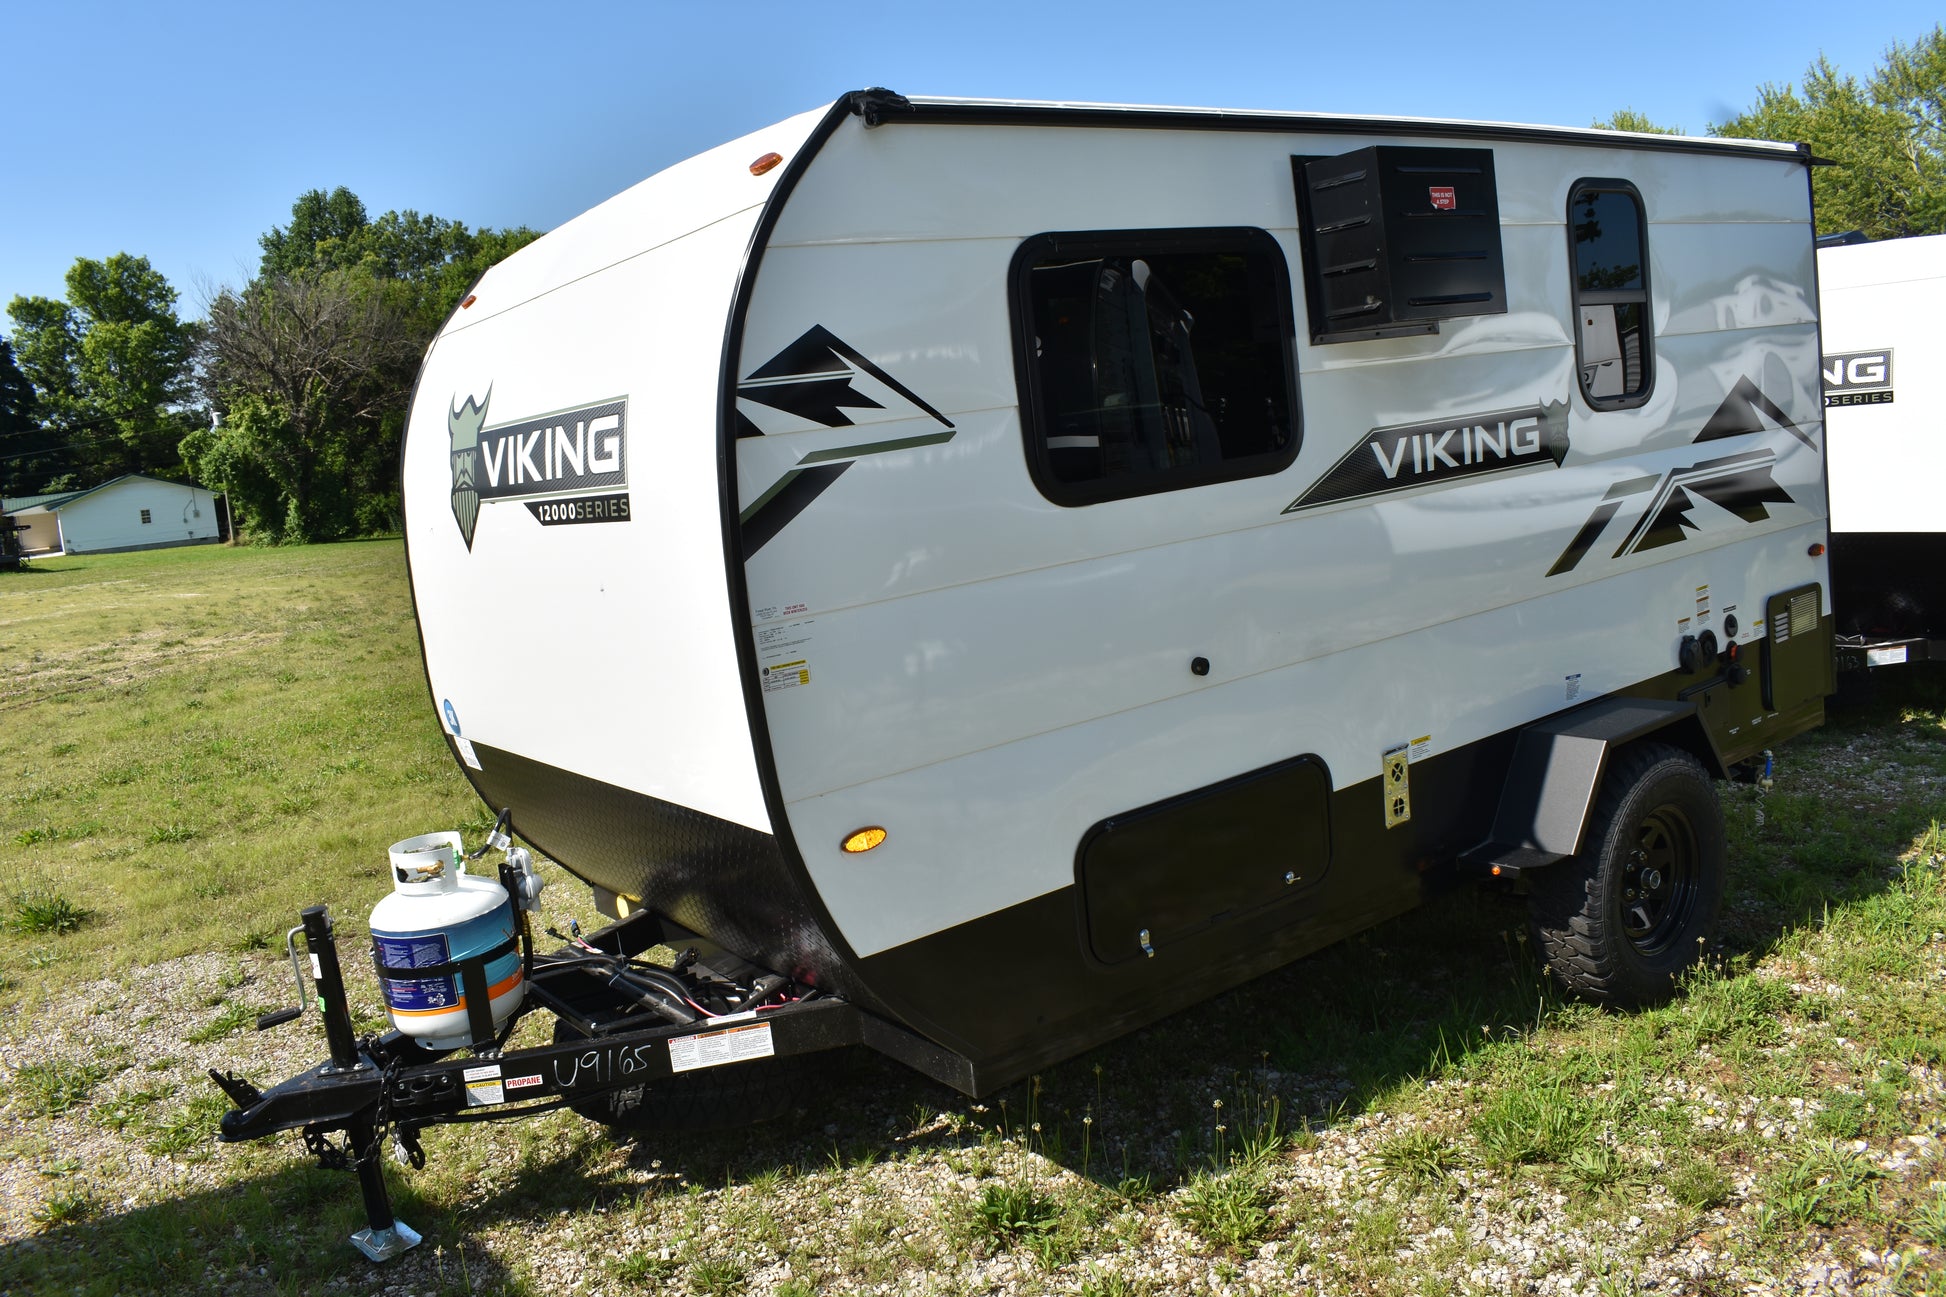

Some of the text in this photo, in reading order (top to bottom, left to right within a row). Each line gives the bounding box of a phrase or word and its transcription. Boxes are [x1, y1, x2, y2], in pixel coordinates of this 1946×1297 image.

[482, 413, 620, 488] VIKING
[1370, 416, 1541, 480] VIKING
[506, 1076, 541, 1088] PROPANE
[553, 1044, 652, 1087] U9165
